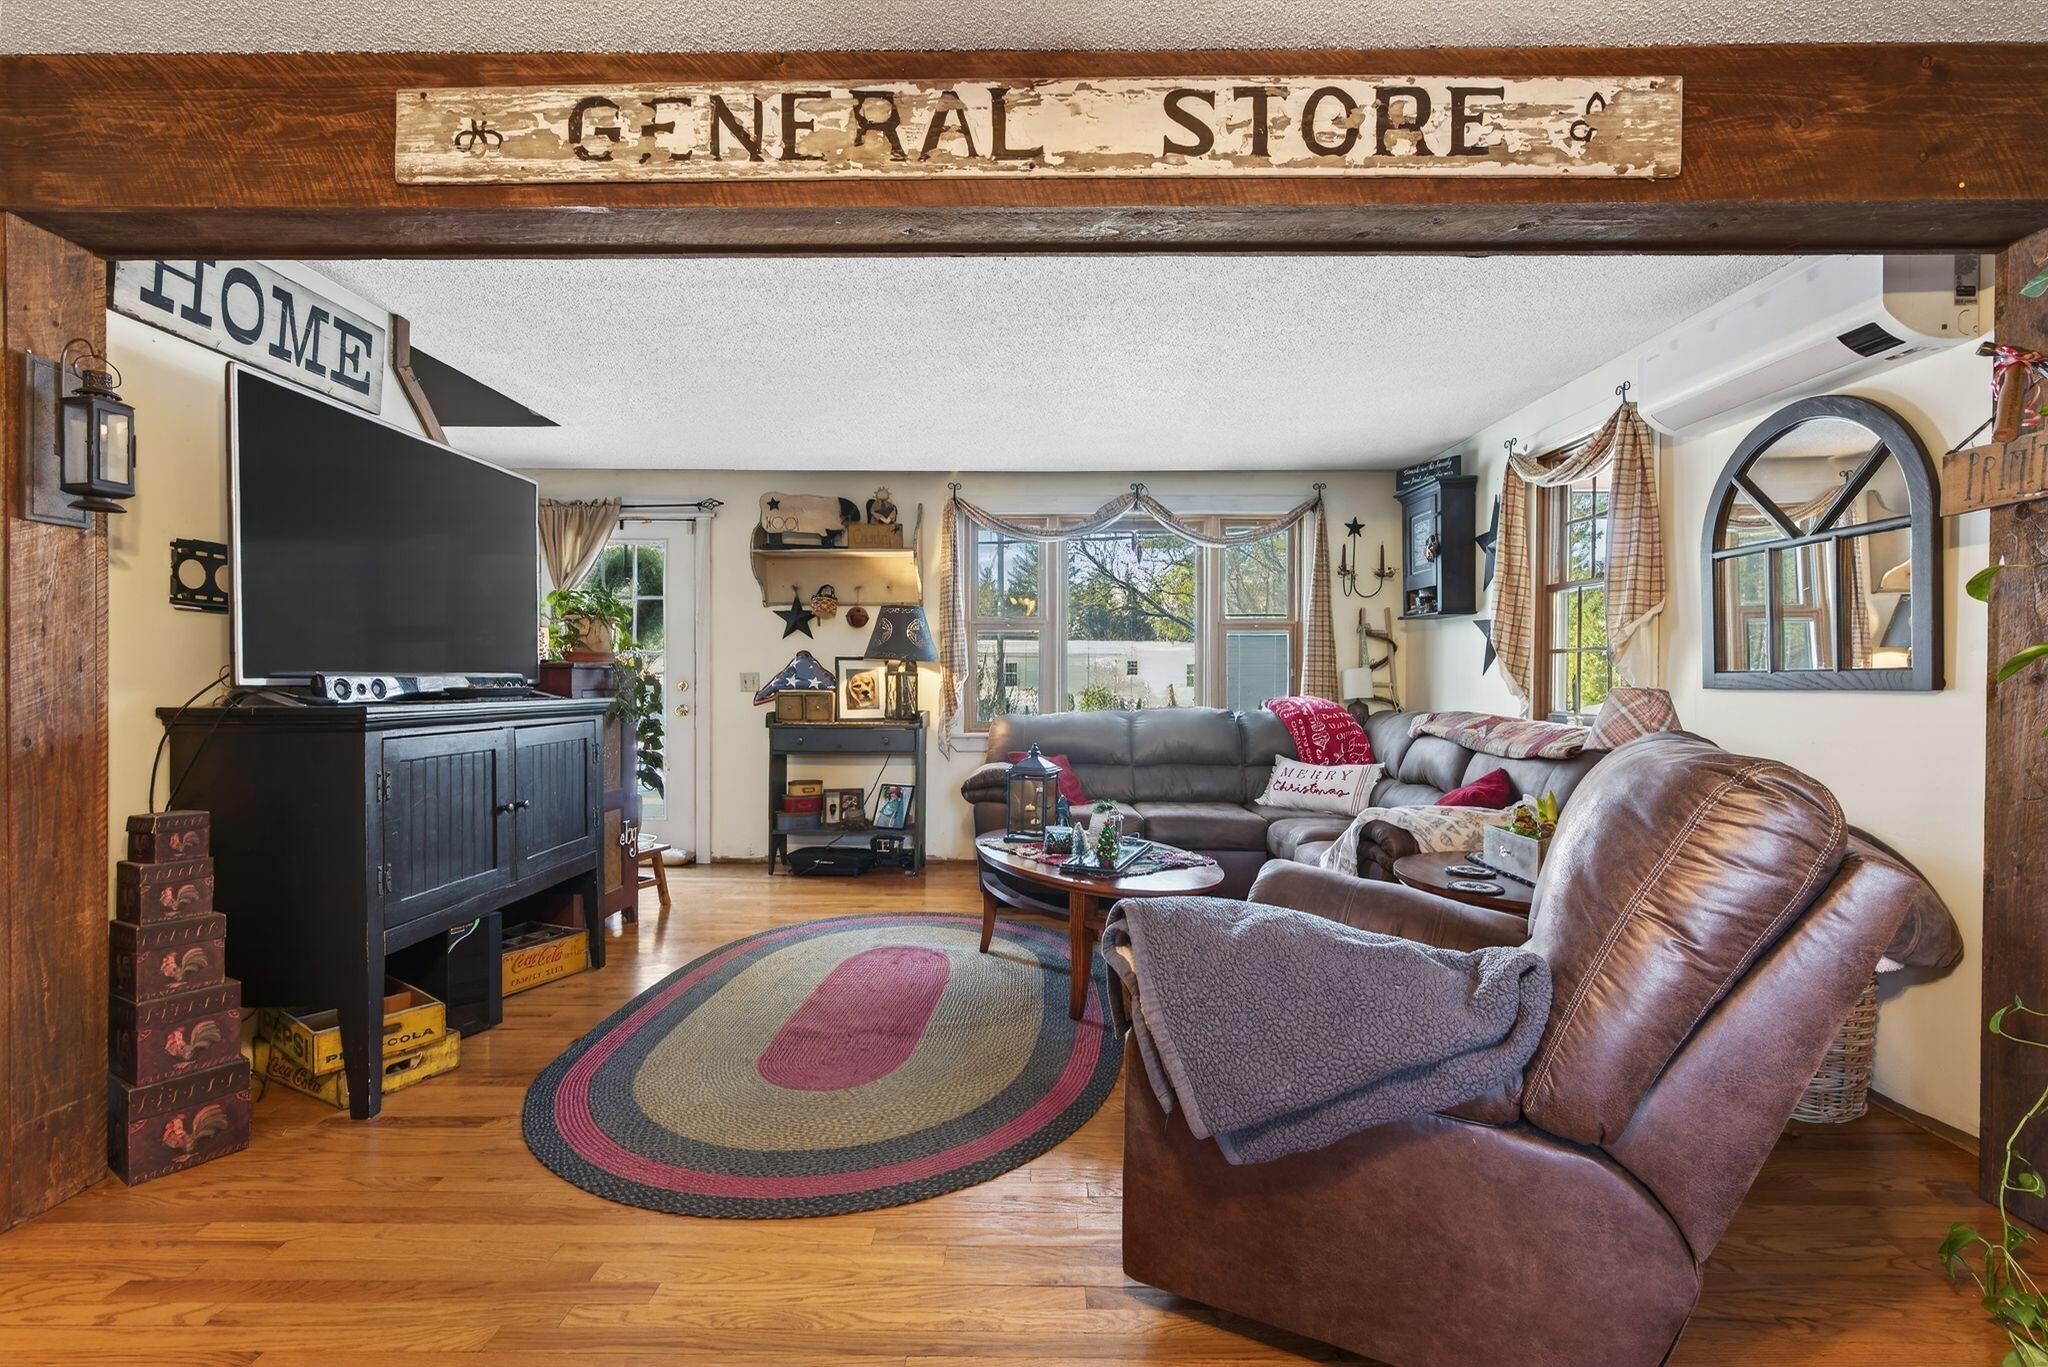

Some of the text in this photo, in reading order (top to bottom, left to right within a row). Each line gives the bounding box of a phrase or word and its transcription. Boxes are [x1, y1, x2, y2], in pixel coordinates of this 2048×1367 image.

[567, 85, 1506, 163] GENERAL STORE
[140, 260, 373, 395] HOME
[1272, 779, 1350, 798] Christmas
[1280, 766, 1354, 782] MERRY
